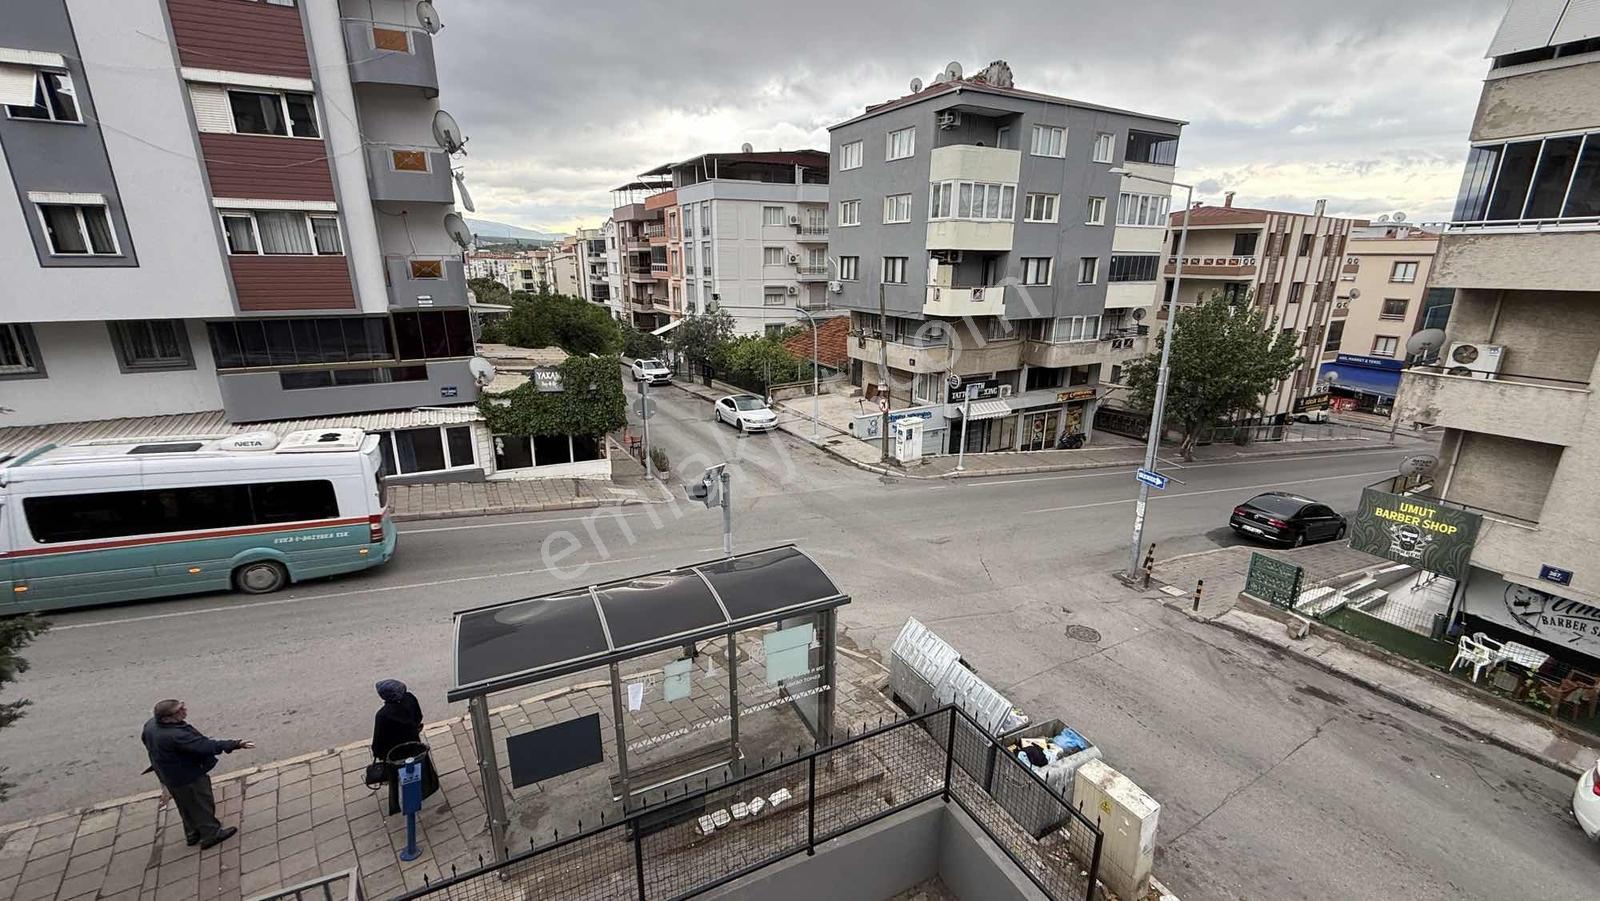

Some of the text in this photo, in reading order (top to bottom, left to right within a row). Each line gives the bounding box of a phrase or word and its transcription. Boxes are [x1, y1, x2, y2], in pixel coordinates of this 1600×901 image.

[1400, 502, 1436, 518] UMUT
[1374, 507, 1457, 535] BARBER SHOP
[1541, 615, 1587, 632] BARBER
